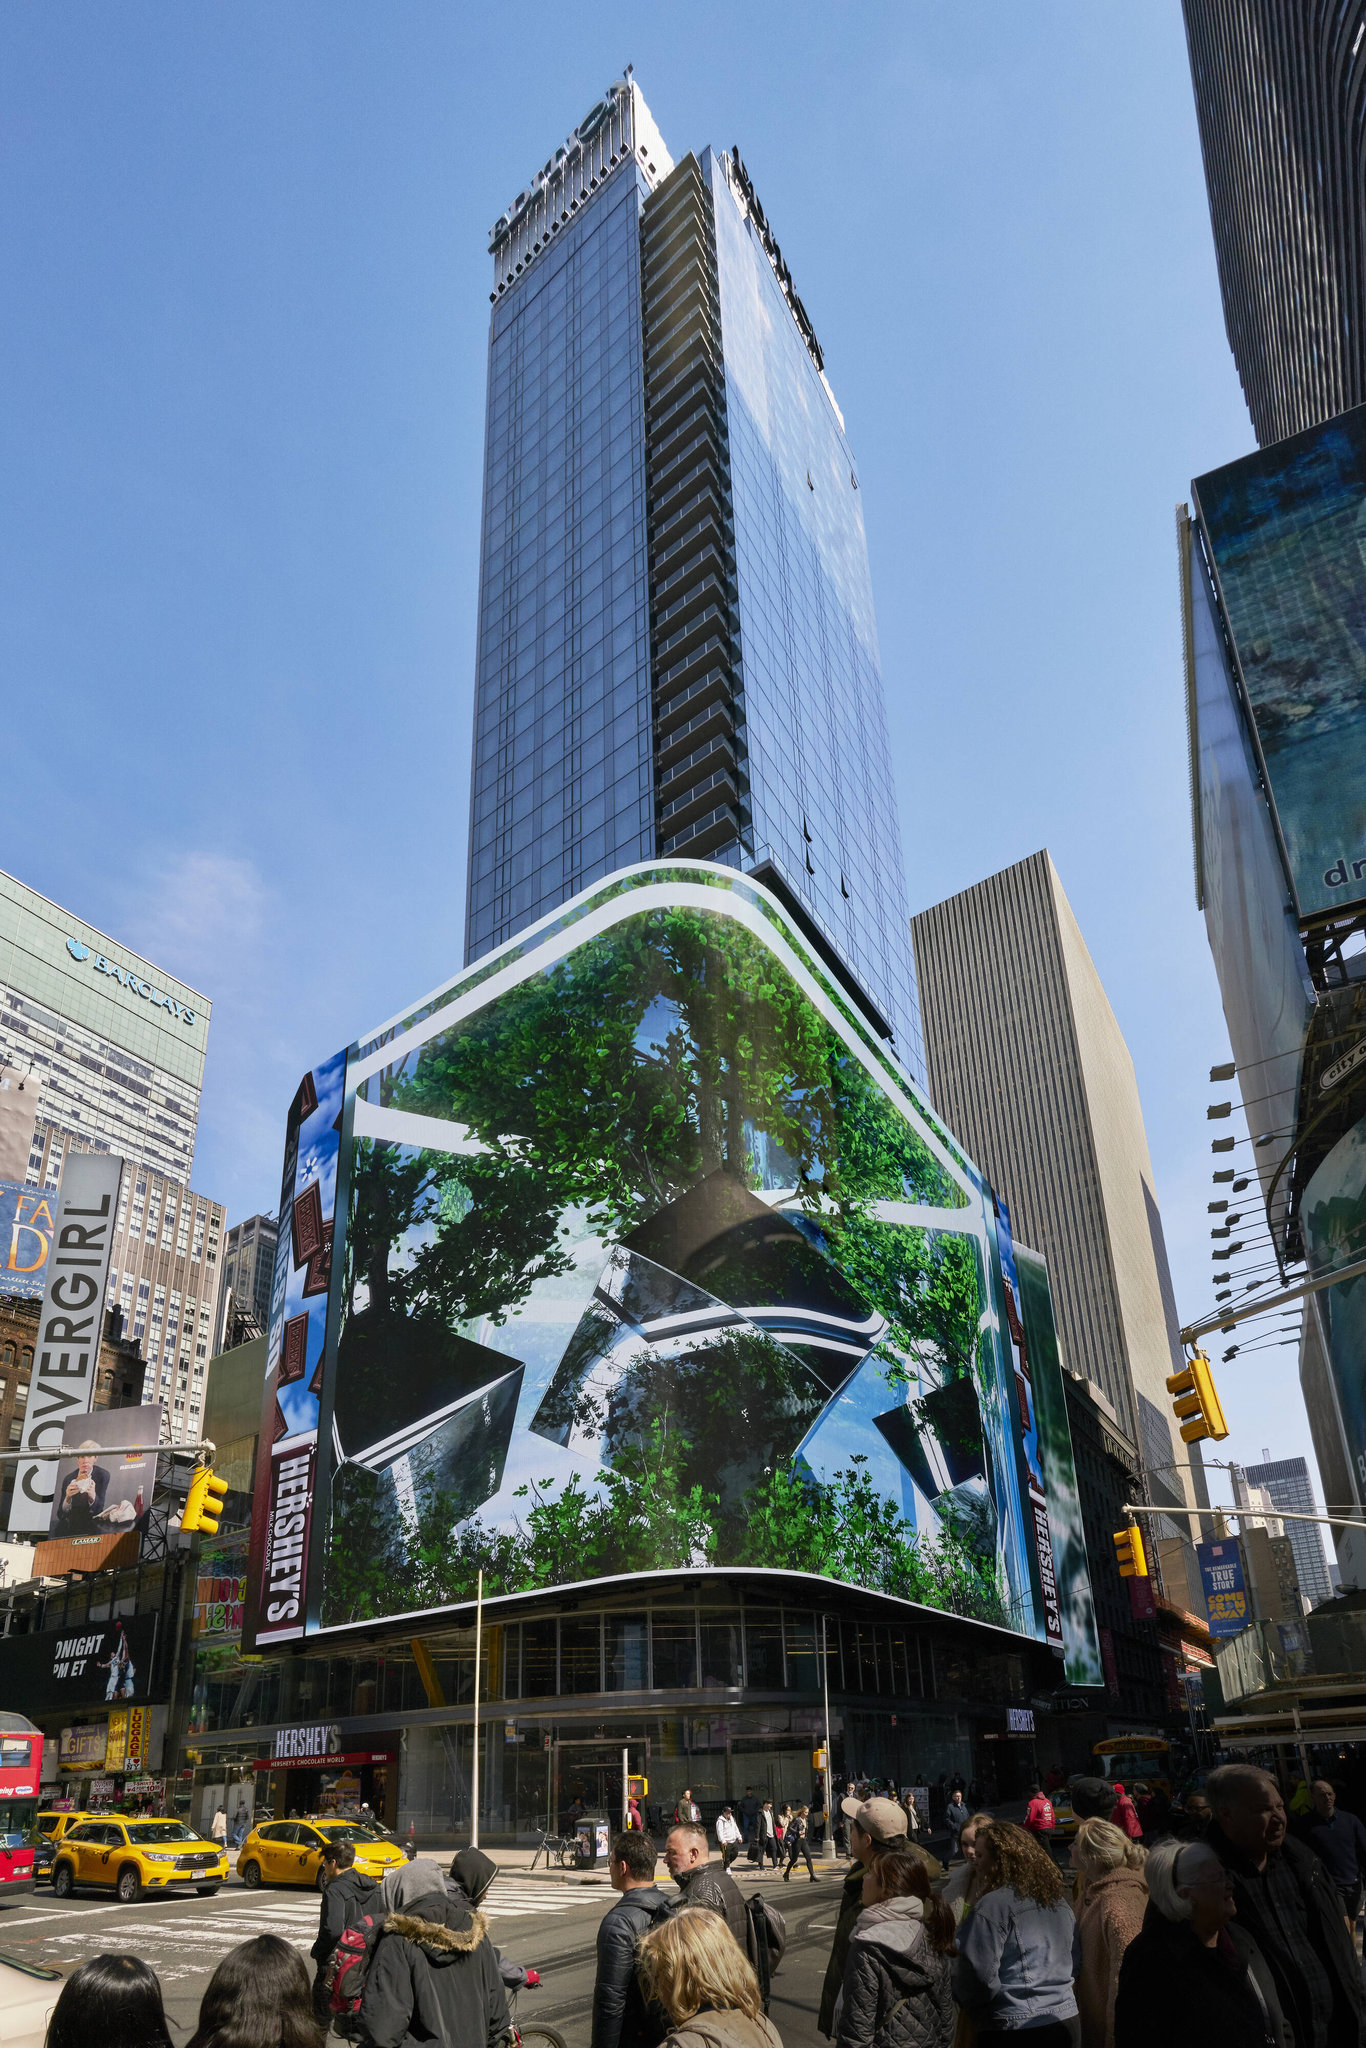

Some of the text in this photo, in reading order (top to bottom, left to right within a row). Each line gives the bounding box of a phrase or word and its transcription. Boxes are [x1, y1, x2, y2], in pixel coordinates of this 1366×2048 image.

[93, 954, 196, 1026] BARCLAYS
[1329, 1053, 1355, 1079] city
[13, 1194, 55, 1229] FA
[22, 1194, 111, 1504] COVERGIRL
[267, 1454, 309, 1623] HERSHEY'S
[1034, 1507, 1060, 1633] HERSHEY'S
[1211, 1569, 1235, 1582] TRUE
[1212, 1580, 1235, 1590] STORY
[1208, 1592, 1244, 1604] COME
[1208, 1600, 1246, 1612] FROM
[1210, 1608, 1245, 1620] AWAY
[55, 1634, 105, 1660] ONIGHT
[71, 1660, 87, 1677] ET
[1007, 1708, 1035, 1731] HERSHEY'S
[67, 1736, 101, 1754] GIFTS
[130, 1709, 142, 1757] LUGGAGE
[276, 1725, 341, 1758] HERSHEY'S
[270, 1759, 296, 1767] HERSHEY'S
[297, 1758, 326, 1766] CHOCOLATE
